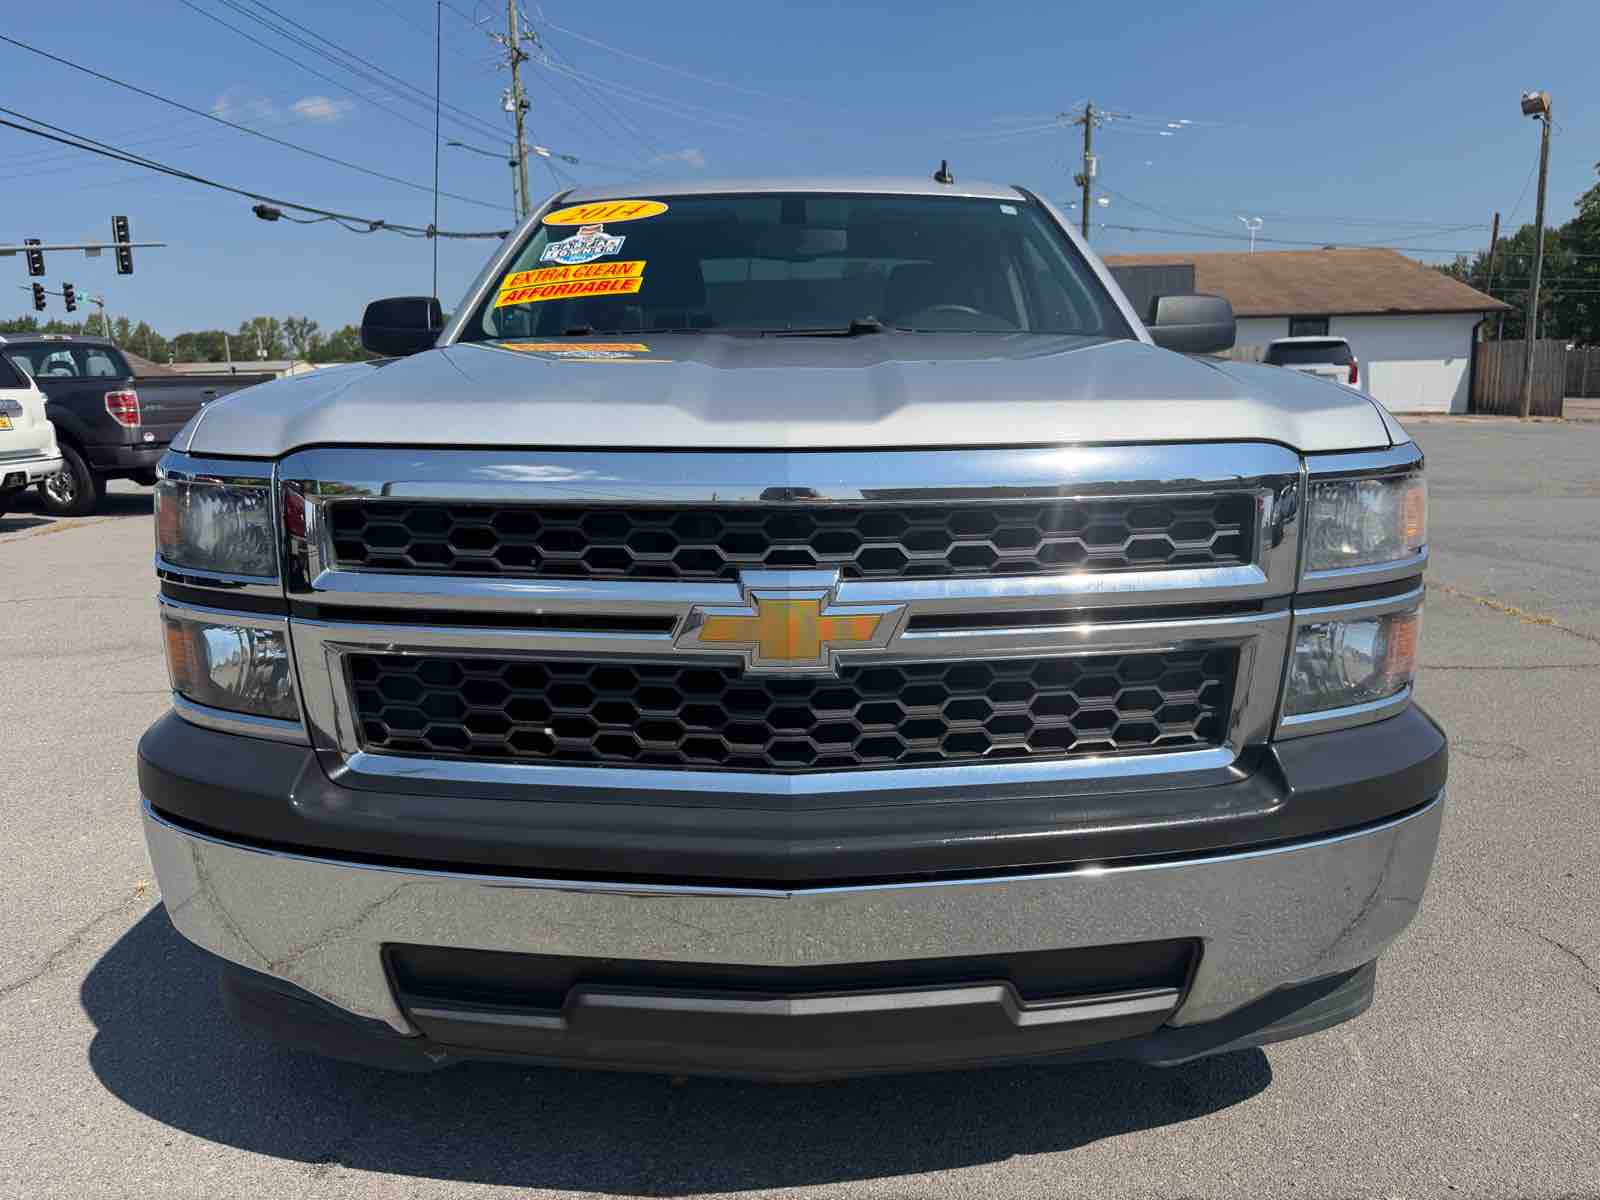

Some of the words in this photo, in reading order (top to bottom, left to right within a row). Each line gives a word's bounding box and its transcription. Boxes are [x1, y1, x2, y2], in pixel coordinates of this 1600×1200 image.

[560, 204, 647, 222] 2014
[510, 267, 570, 286] EXTRA
[573, 263, 633, 278] CLEAN
[502, 280, 634, 303] AFFORDABLE
